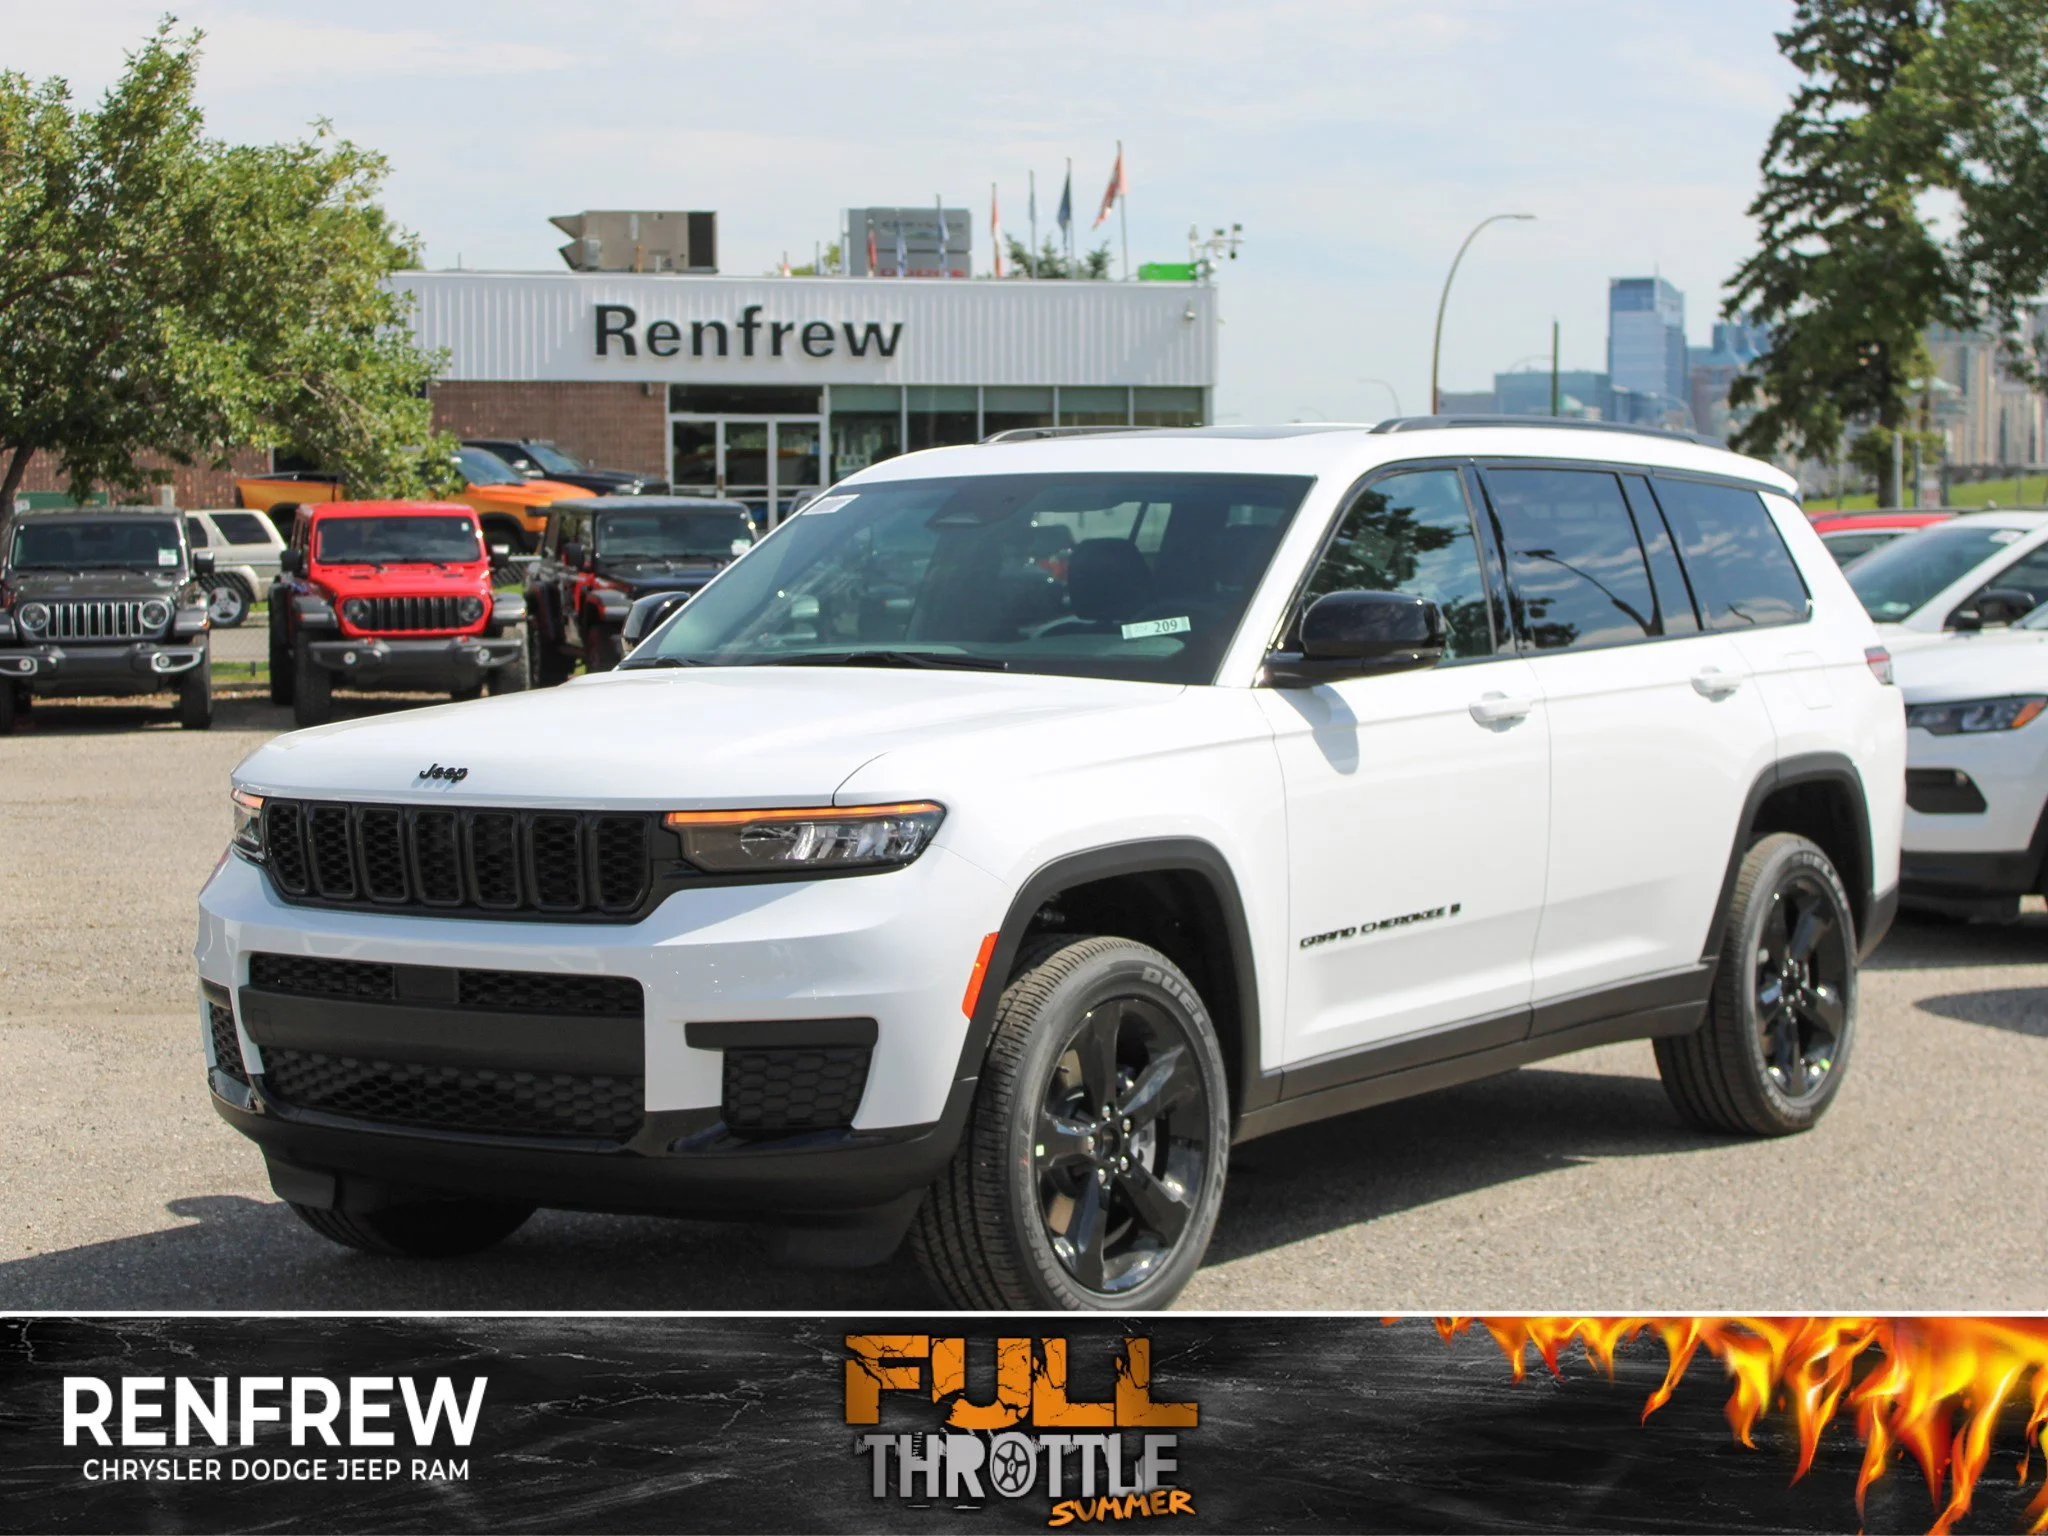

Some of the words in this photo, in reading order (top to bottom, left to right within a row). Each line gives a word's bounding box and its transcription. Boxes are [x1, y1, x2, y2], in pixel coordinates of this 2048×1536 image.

[595, 305, 904, 358] Renfrew
[1154, 619, 1178, 633] 209
[419, 763, 468, 783] Jeep
[1299, 927, 1357, 949] GRAND
[1360, 907, 1446, 935] CHEROKEE
